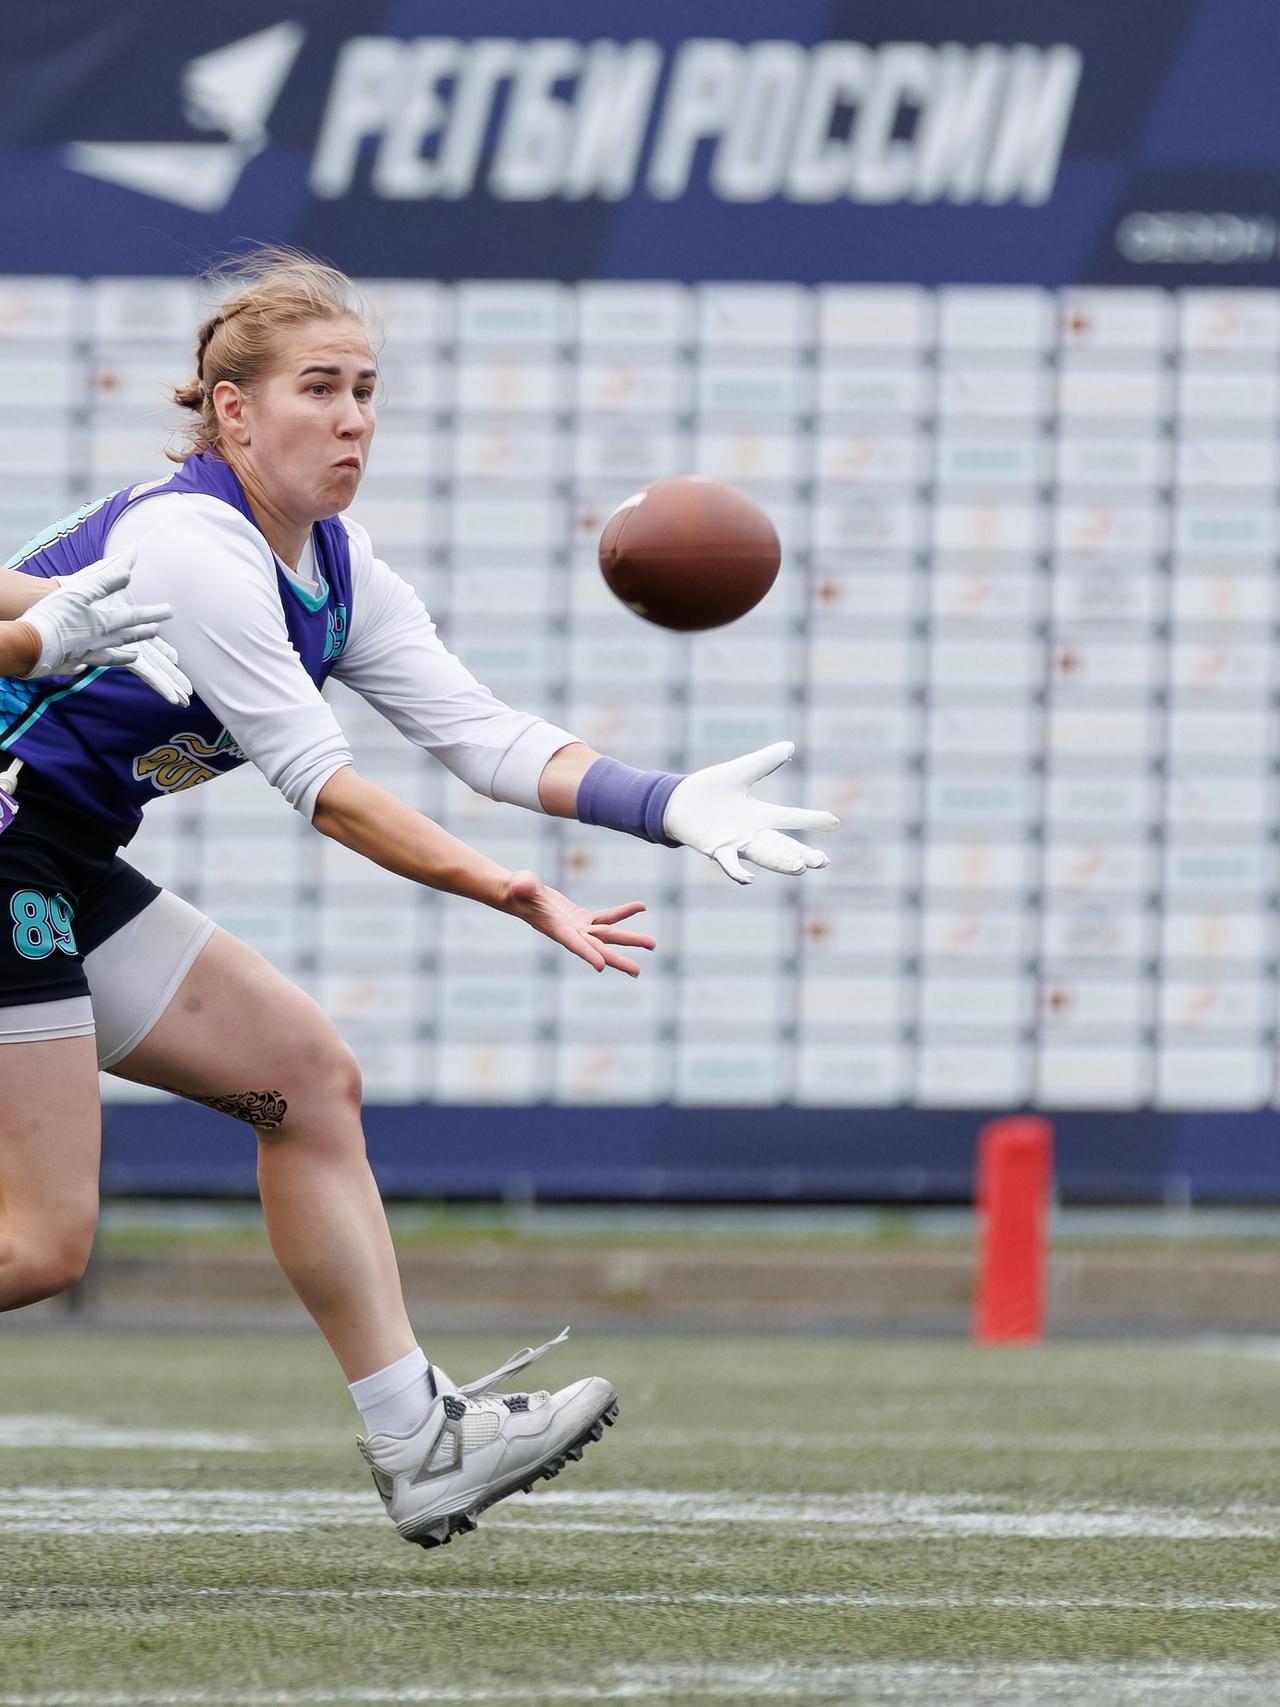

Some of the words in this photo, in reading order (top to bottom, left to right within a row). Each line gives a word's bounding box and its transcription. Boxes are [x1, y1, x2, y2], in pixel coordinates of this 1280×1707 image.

[311, 37, 663, 199] РЕГБИ
[648, 38, 1082, 207] РОССИИ
[10, 889, 78, 960] 89
